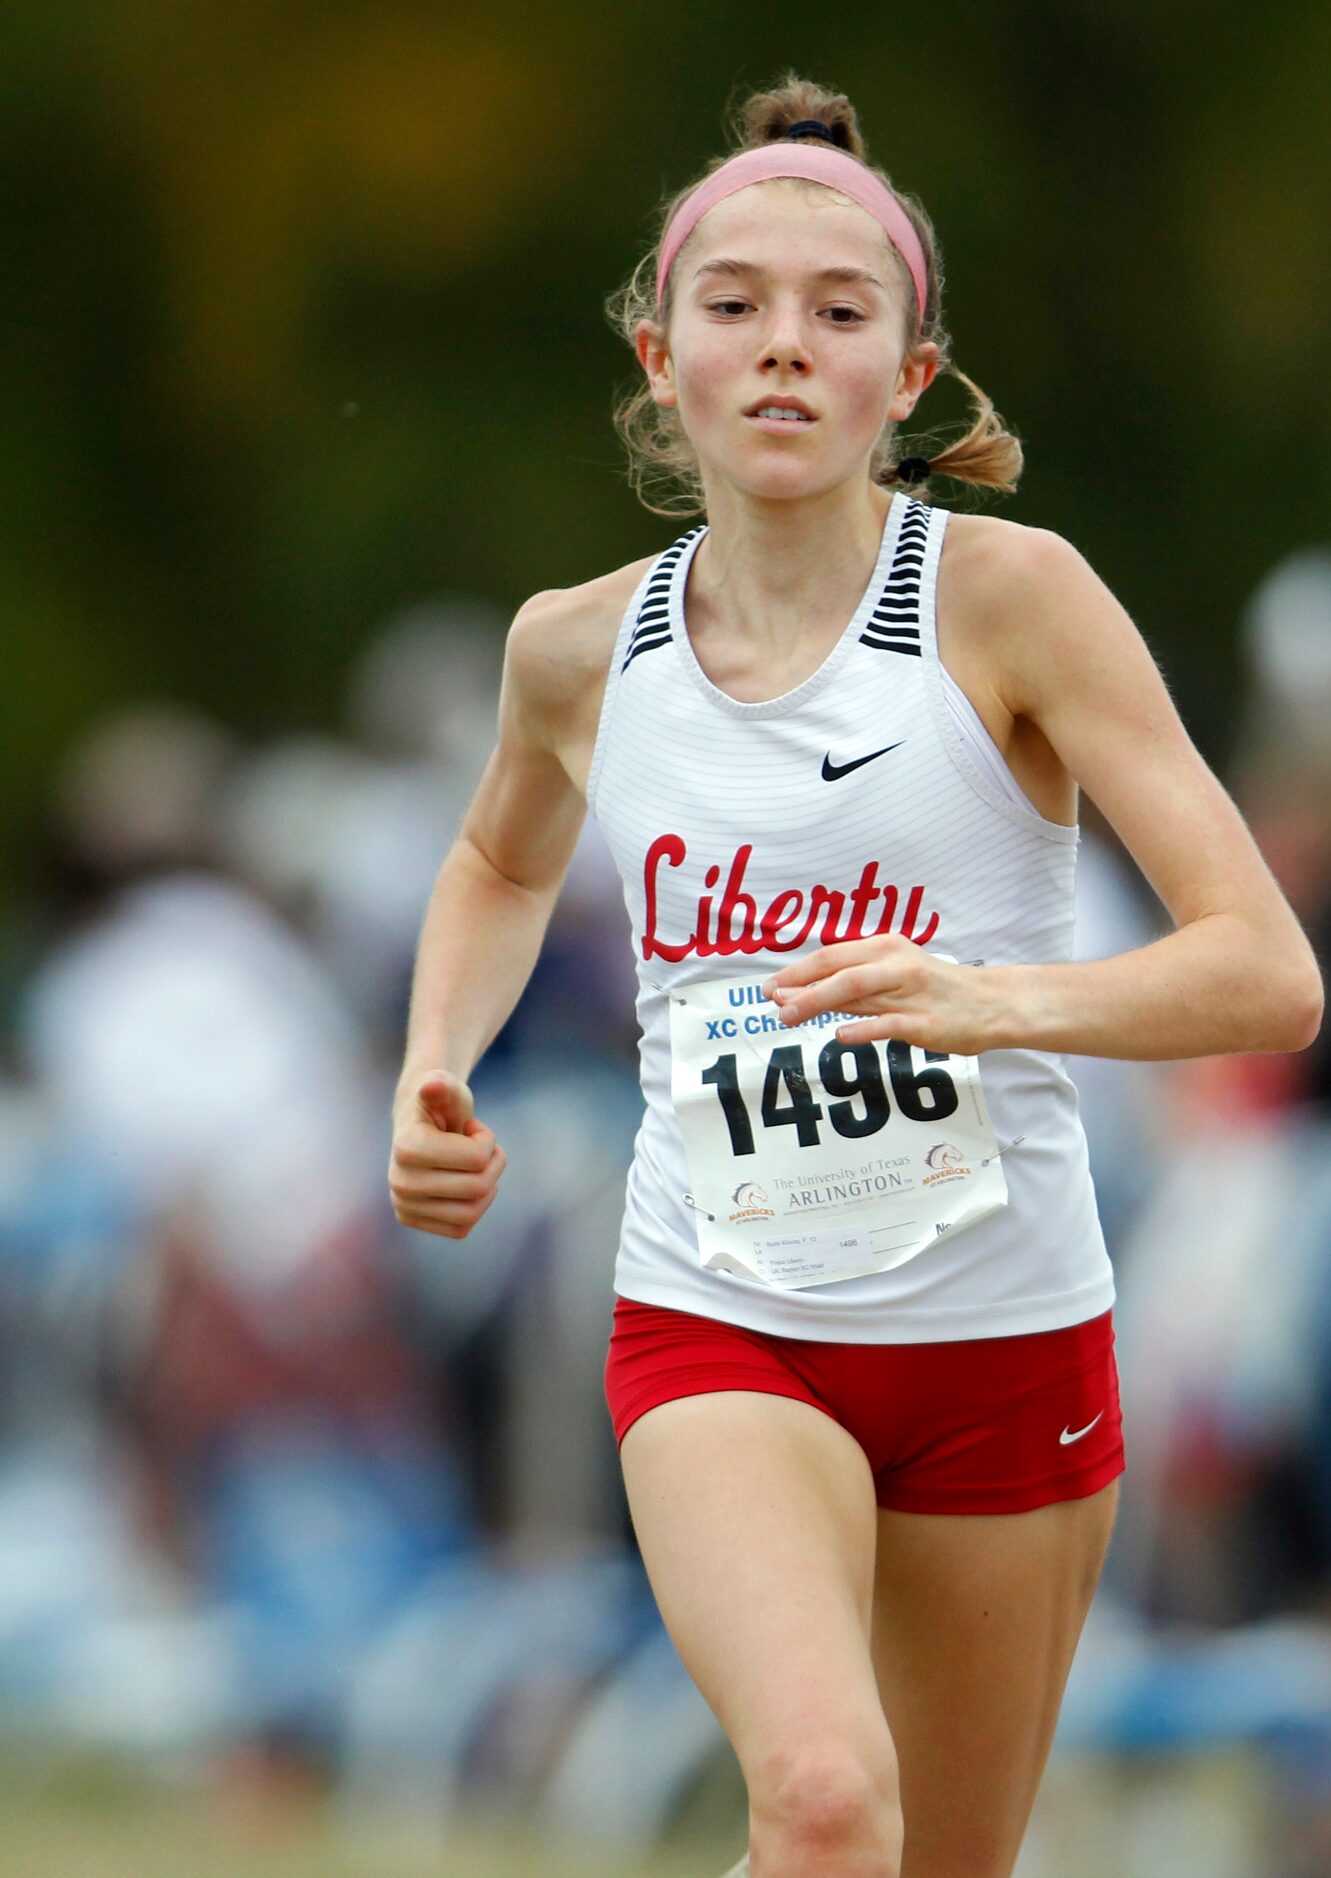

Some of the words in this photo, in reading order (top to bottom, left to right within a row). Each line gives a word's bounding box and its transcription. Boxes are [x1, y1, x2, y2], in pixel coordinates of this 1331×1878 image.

[642, 833, 940, 963] Liberty
[728, 984, 773, 1007] UIL
[705, 1018, 738, 1040] XC
[701, 1039, 960, 1157] 1496
[773, 1178, 795, 1190] The
[797, 1168, 856, 1187] University
[860, 1162, 874, 1175] of
[878, 1156, 912, 1171] Texas
[789, 1171, 903, 1208] ARLINGTON
